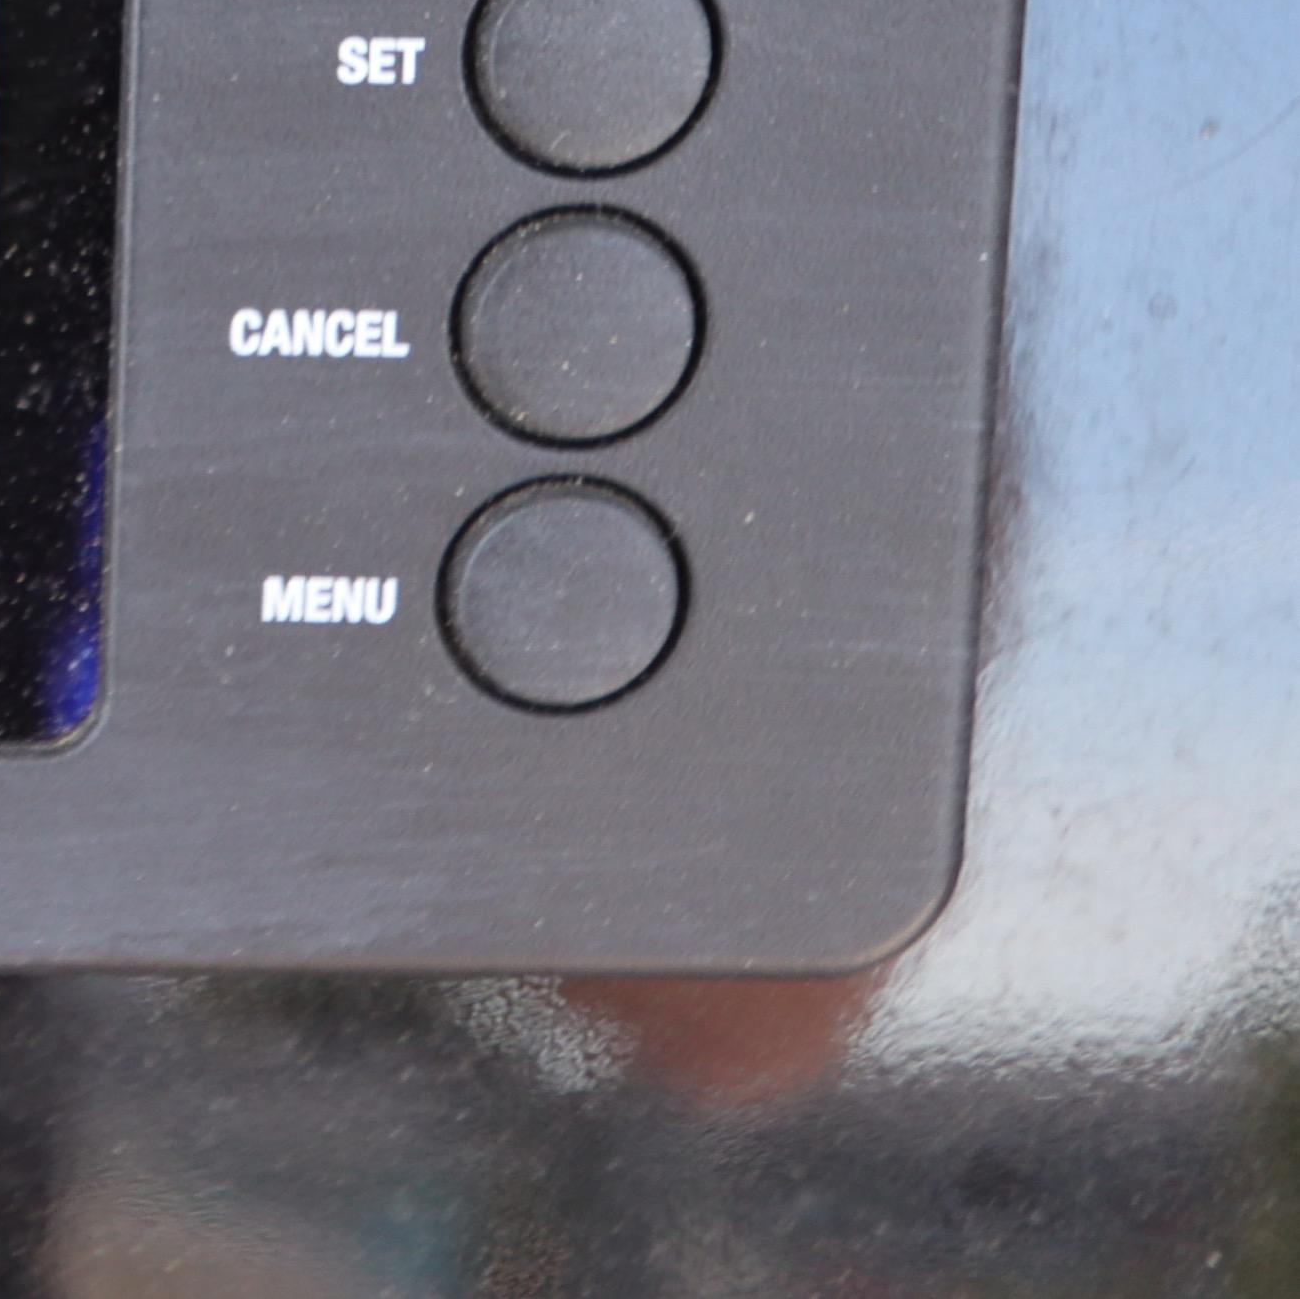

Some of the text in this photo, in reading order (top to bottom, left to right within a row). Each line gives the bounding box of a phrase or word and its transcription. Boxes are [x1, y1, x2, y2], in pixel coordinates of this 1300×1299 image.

[337, 37, 425, 85] SET
[229, 308, 410, 358] CANCEL
[261, 576, 397, 624] MENU
